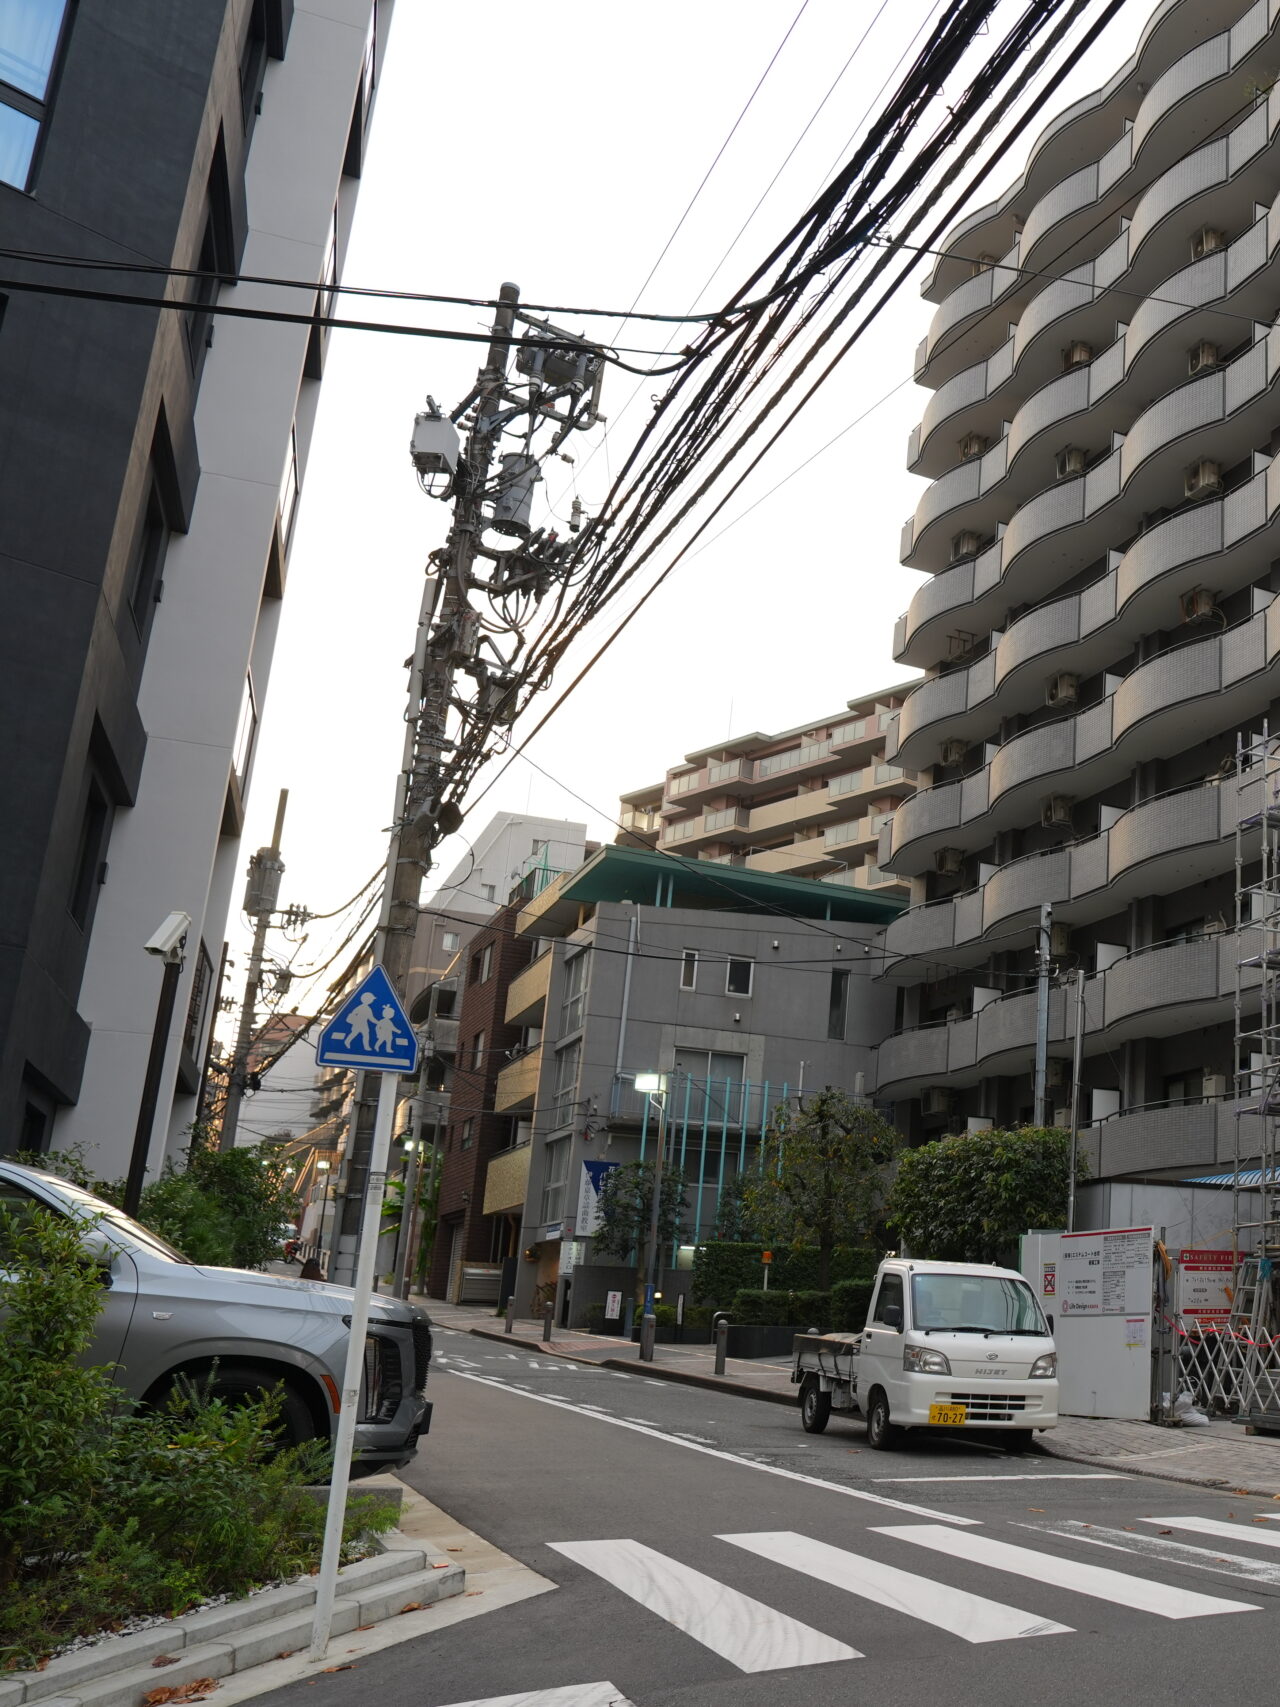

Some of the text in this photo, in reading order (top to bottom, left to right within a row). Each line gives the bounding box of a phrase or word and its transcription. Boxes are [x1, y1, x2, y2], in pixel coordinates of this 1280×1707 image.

[1076, 1303, 1088, 1311] Design
[975, 1368, 1008, 1376] HIJET
[937, 1412, 964, 1424] 70-27
